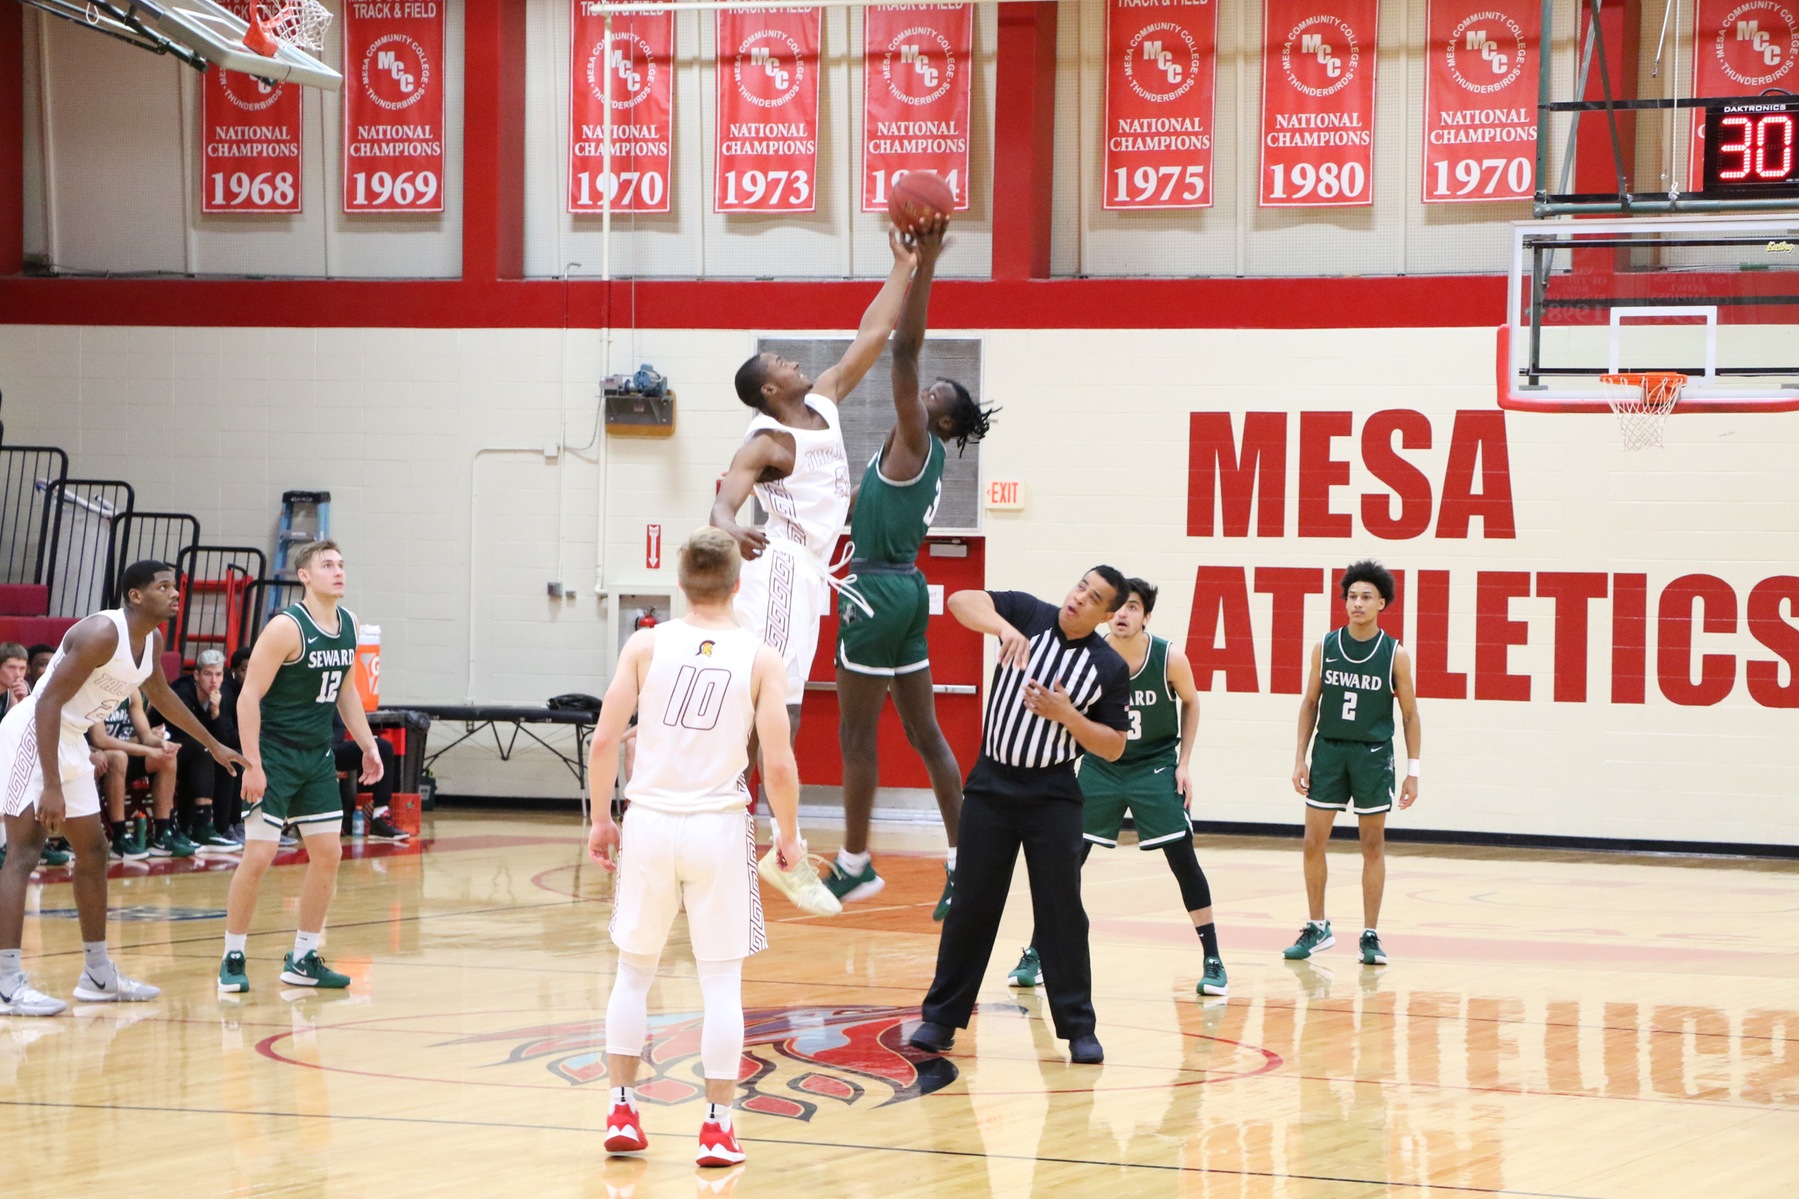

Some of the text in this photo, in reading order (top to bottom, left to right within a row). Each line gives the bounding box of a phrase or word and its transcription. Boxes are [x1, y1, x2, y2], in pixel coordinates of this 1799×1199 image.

[353, 2, 437, 19] TRACK & FIELD
[1282, 15, 1359, 70] MESA COMMUNITY COLLEGE
[1446, 11, 1526, 67] MESA COMMUNITY COLLEGE
[1716, 1, 1799, 58] MESA COMMUNITY COLLEGE
[1736, 20, 1781, 66] MCC
[362, 33, 429, 84] MESA COMMUNITY COLLEGE
[587, 56, 596, 83] MESA
[639, 40, 656, 83] COLLEGE
[734, 29, 804, 82] MESA COMMUNITY COLLEGE
[882, 26, 955, 80] MESA COMMUNITY COLLEGE
[1124, 22, 1199, 76] MESA COMMUNITY COLLEGE
[1142, 40, 1183, 84] MCC
[1301, 33, 1341, 78] MCC
[1466, 30, 1508, 74] MCC
[377, 51, 414, 93] MCC
[611, 49, 641, 92] MCC
[750, 47, 789, 90] MCC
[900, 44, 939, 88] MCC
[1452, 67, 1521, 94] THUNDERBIRDS
[1721, 59, 1794, 86] THUNDERBIRDS
[224, 88, 282, 111] THUNDERBIRDS
[366, 88, 425, 110] THUNDERBIRDS
[738, 84, 800, 108] THUNDERBIRDS
[888, 82, 951, 106] THUNDERBIRDS
[1129, 78, 1195, 103] THUNDERBIRDS
[1287, 71, 1354, 97] THUNDERBIRDS
[1275, 112, 1362, 129] NATIONAL
[1440, 108, 1530, 126] NATIONAL
[1723, 104, 1787, 113] DAKTRONICS
[215, 125, 291, 140] NATIONAL
[357, 125, 433, 139] NATIONAL
[729, 123, 808, 138] NATIONAL
[877, 121, 959, 136] NATIONAL
[1118, 117, 1203, 133] NATIONAL
[1266, 130, 1370, 147] CHAMPIONS
[1429, 126, 1537, 145] CHAMPIONS
[207, 143, 298, 157] CHAMPIONS
[350, 141, 441, 157] CHAMPIONS
[721, 140, 815, 156] CHAMPIONS
[868, 138, 966, 154] CHAMPIONS
[1110, 134, 1211, 152] CHAMPIONS
[1720, 116, 1792, 178] 30
[211, 171, 295, 206] 1968
[353, 171, 438, 205] 1969
[724, 169, 810, 205] 1973
[871, 168, 960, 203] 14
[1113, 165, 1204, 202] 1975
[1269, 161, 1365, 199] 1980
[1433, 157, 1532, 195] 1970
[1186, 408, 1517, 540] MESA
[991, 482, 1019, 503] EXIT
[1184, 564, 1799, 709] ATLETICS
[307, 648, 355, 668] SEWARD
[315, 670, 342, 703] 12
[1324, 669, 1382, 691] SEWARD
[663, 664, 732, 731] 10
[1341, 691, 1358, 721] 2
